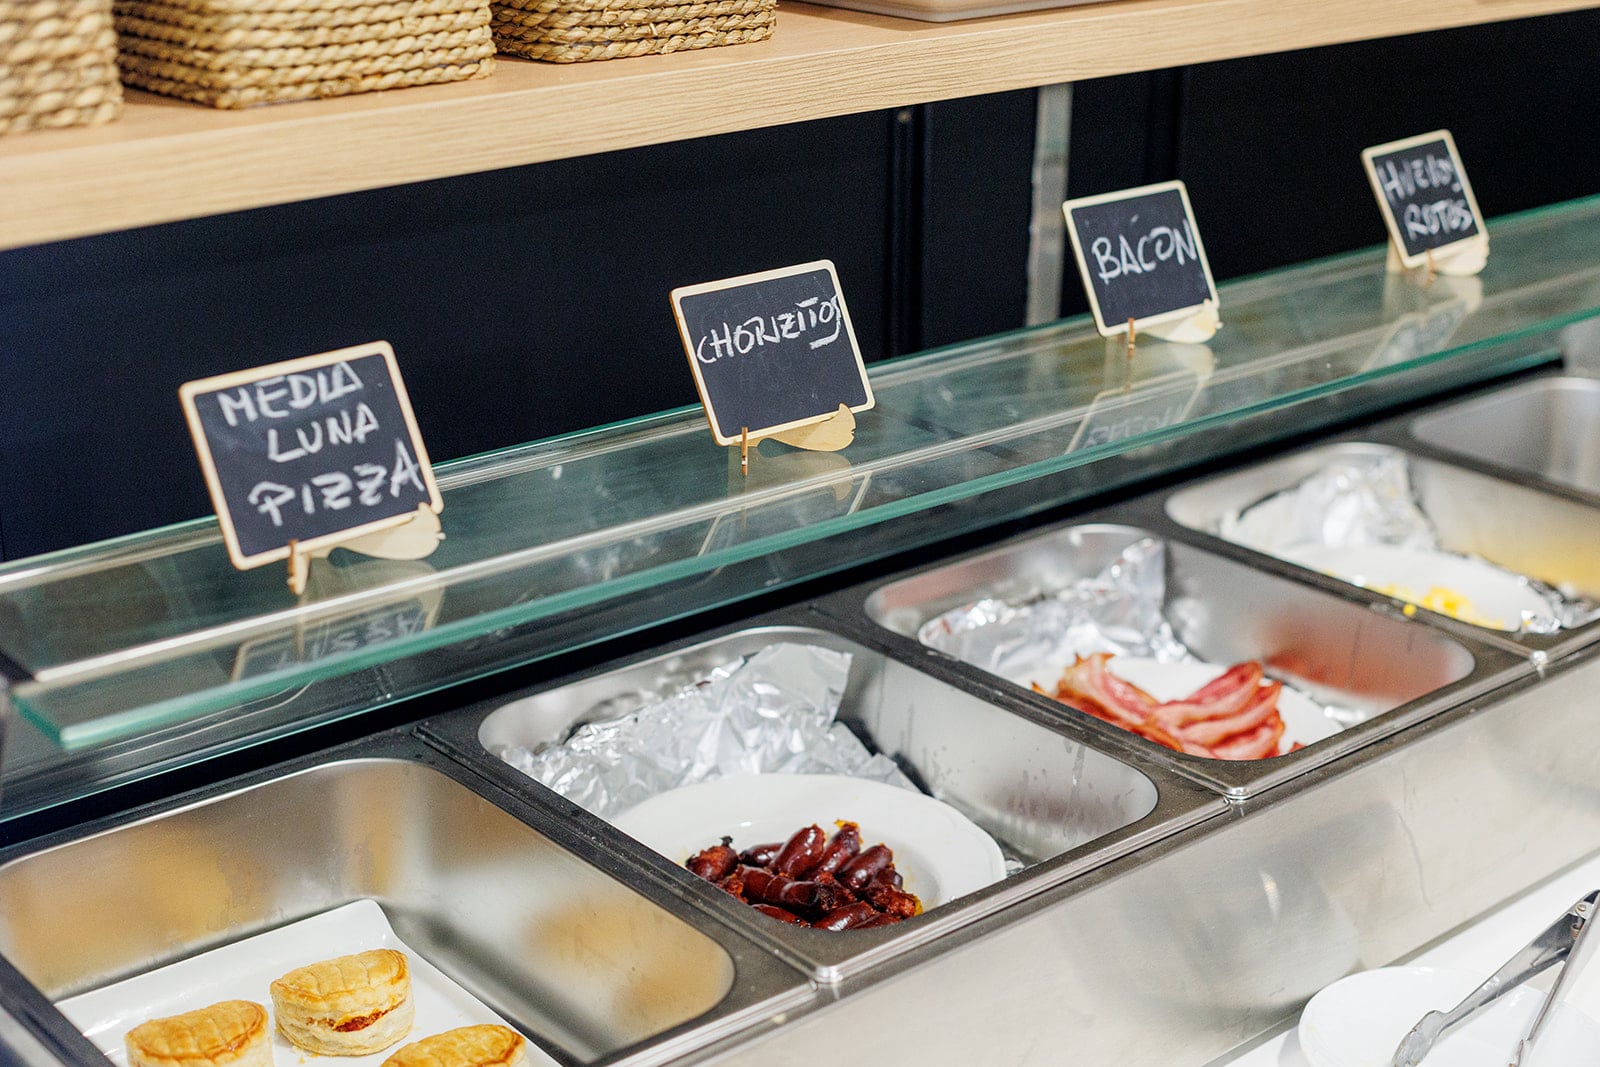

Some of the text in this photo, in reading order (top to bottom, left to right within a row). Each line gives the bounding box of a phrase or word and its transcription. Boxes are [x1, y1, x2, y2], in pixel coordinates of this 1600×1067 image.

[1092, 219, 1197, 285] BACON
[1404, 199, 1473, 241] ROTOS
[697, 295, 842, 364] CHORIZITOS
[217, 361, 364, 427] MEDIA
[267, 403, 380, 463] LUNA
[247, 438, 425, 527] PIZZA
